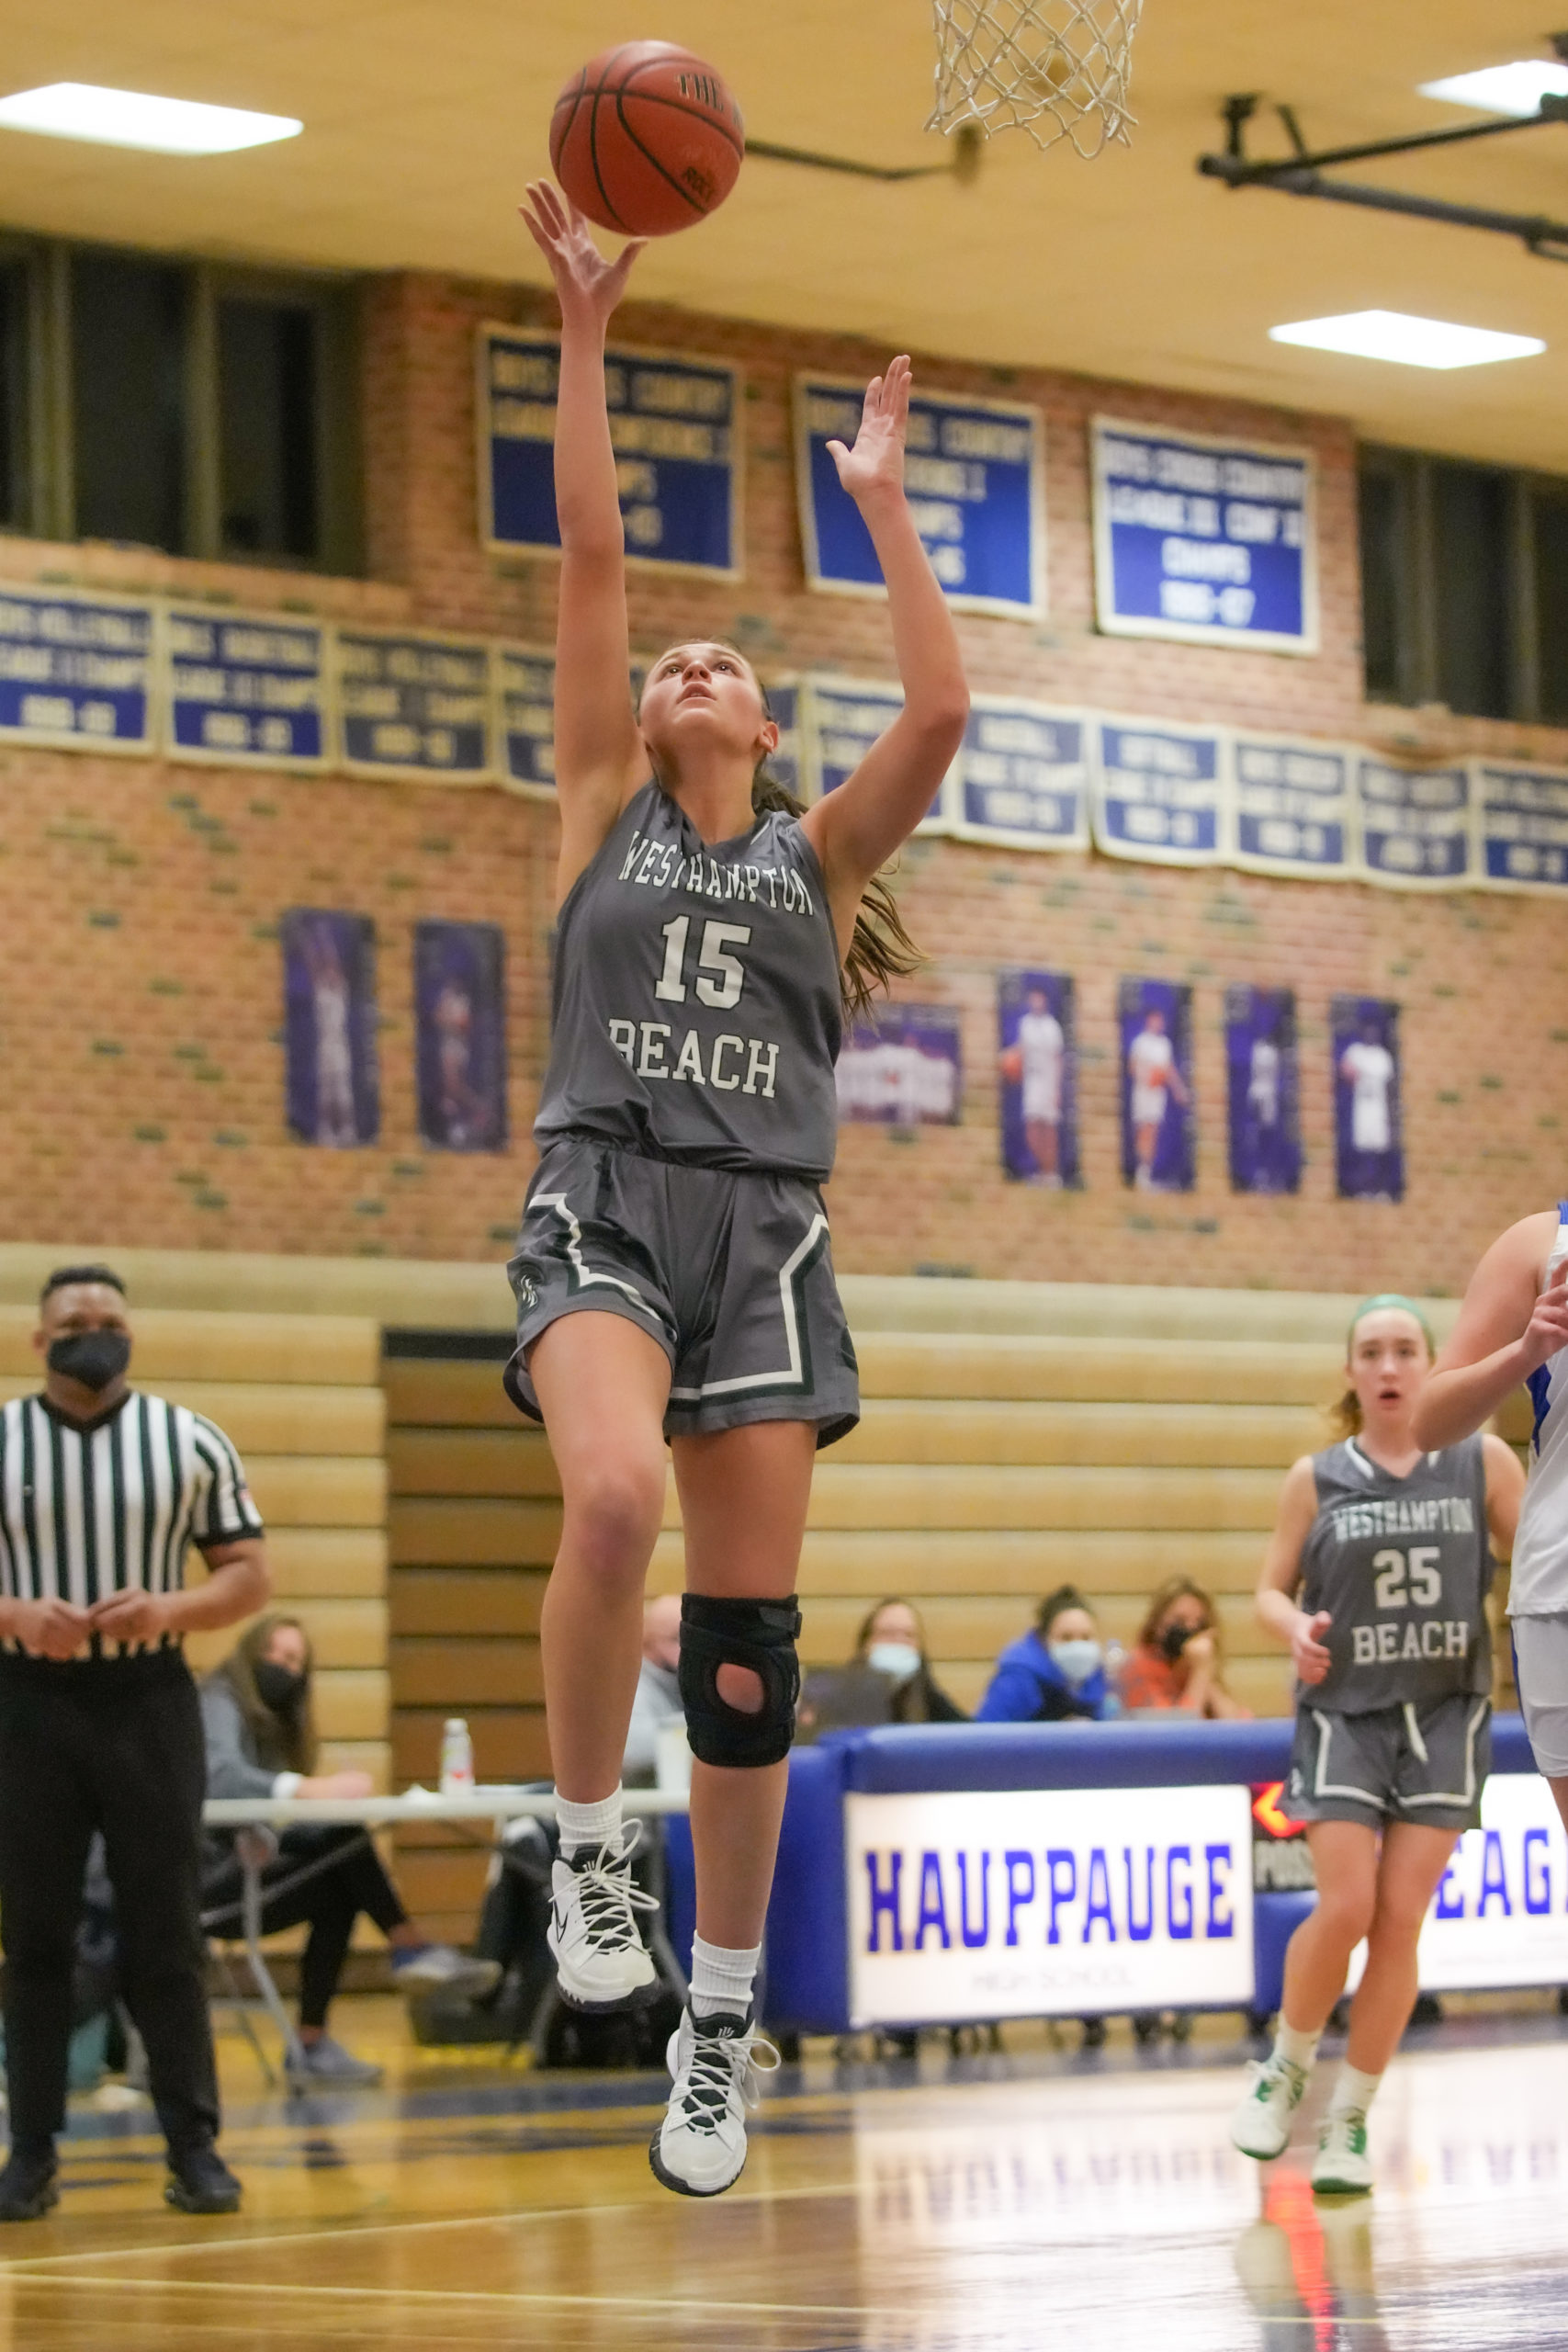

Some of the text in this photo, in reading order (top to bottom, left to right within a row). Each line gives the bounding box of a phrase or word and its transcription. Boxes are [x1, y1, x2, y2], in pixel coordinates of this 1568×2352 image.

[617, 830, 815, 916] WESTHAMPTON
[654, 915, 752, 1011] 15
[607, 1018, 780, 1099] BEACH
[1332, 1496, 1475, 1544] WESTHAMPTON
[1371, 1545, 1443, 1609] 25
[1351, 1620, 1470, 1666] BEACH
[864, 1842, 1235, 1952] HAUPPAUGE
[1435, 1827, 1568, 1919] EAG
